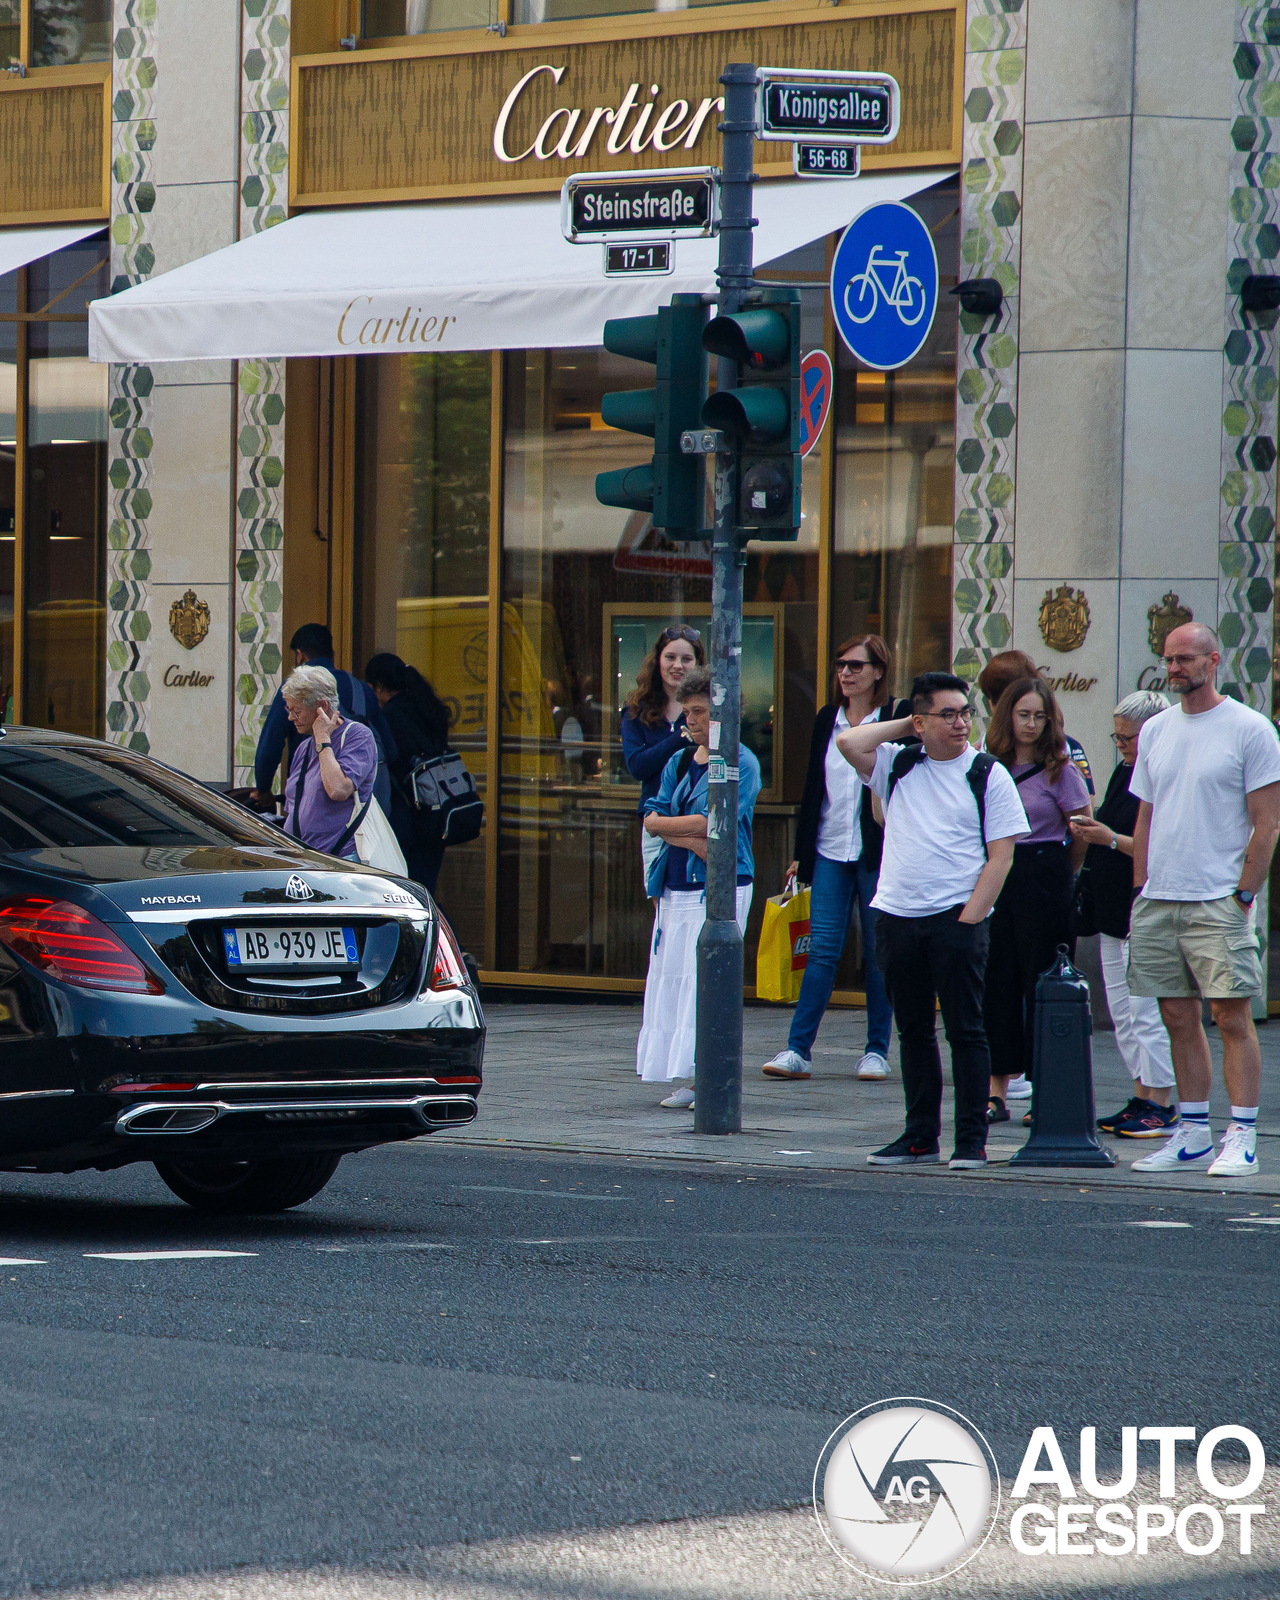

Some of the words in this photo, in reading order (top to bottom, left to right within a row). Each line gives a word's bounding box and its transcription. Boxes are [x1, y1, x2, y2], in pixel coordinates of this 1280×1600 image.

[493, 64, 725, 163] Cartier
[779, 89, 881, 125] Königsallee
[809, 148, 848, 169] 56-68
[583, 188, 695, 222] Steinstraße
[622, 247, 654, 268] 17-1
[337, 294, 457, 346] Cartier
[163, 664, 215, 687] Cartier
[141, 894, 201, 905] MAYBACH
[382, 893, 416, 905] S600
[228, 950, 239, 959] AL
[245, 931, 270, 960] AB
[279, 930, 316, 959] 939
[321, 930, 346, 959] JE
